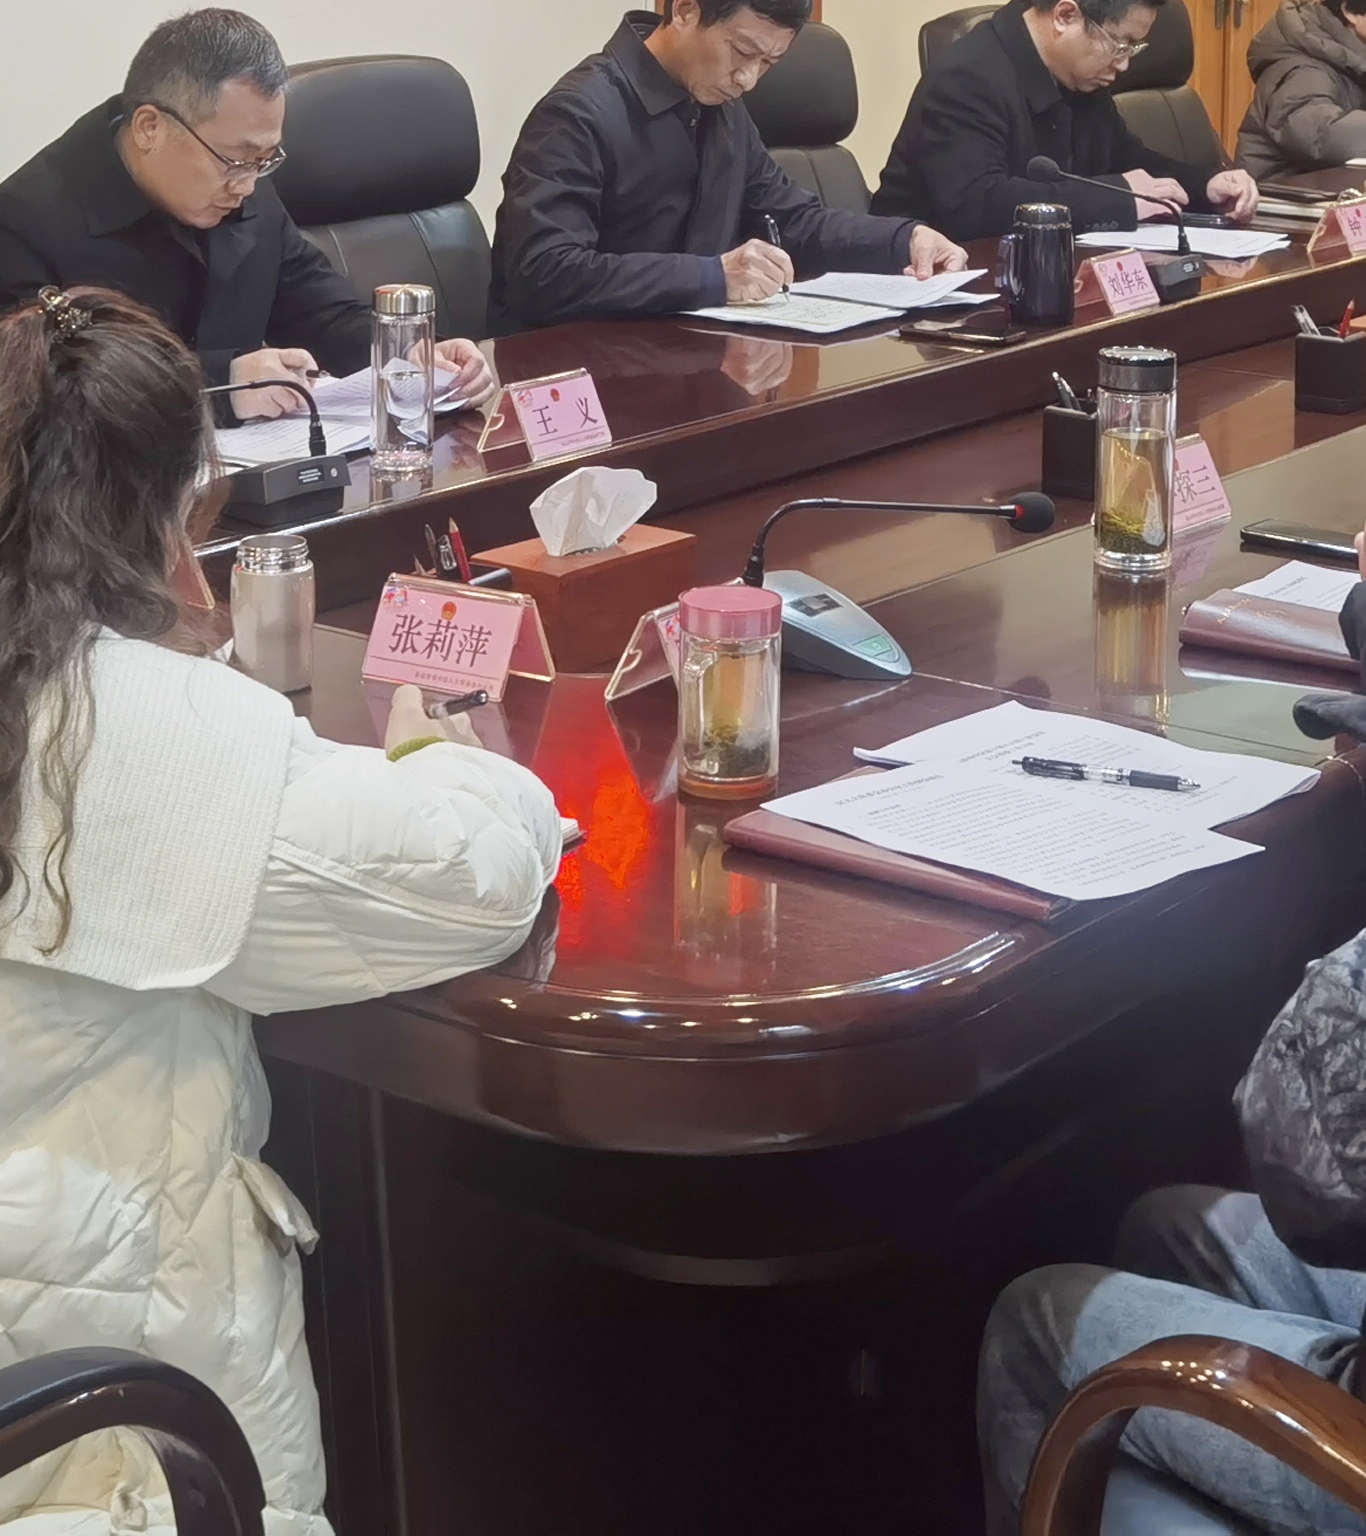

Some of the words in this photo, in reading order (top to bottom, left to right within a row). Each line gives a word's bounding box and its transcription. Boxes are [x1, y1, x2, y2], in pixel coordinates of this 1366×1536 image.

[1108, 268, 1149, 298] 刘华东
[1173, 464, 1216, 505] 探三
[388, 614, 493, 669] 张莉萍
